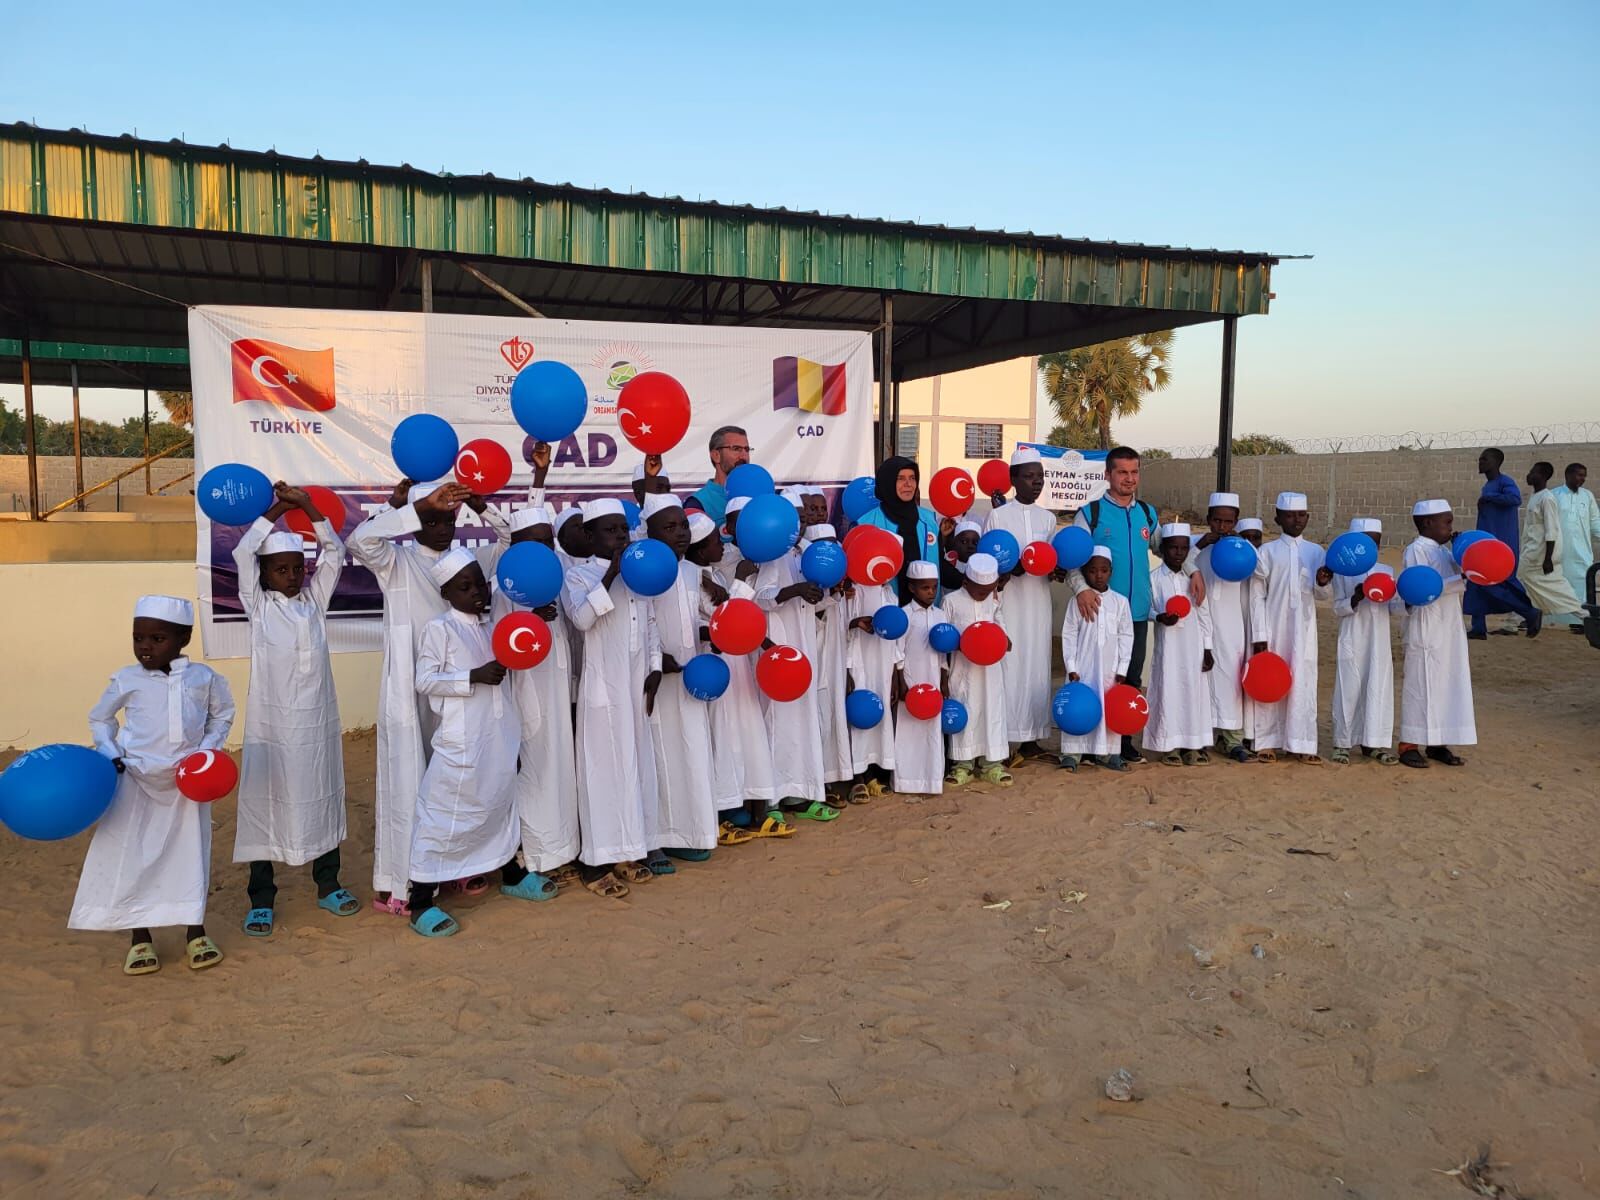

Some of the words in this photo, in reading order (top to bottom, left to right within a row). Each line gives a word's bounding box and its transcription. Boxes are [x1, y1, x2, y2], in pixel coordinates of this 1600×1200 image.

[476, 385, 512, 395] DİYAN
[250, 418, 322, 433] TÜRKİYE
[797, 425, 823, 438] ÇAD
[1050, 480, 1091, 490] YADOĞLU
[1051, 491, 1087, 500] MESCİDİ
